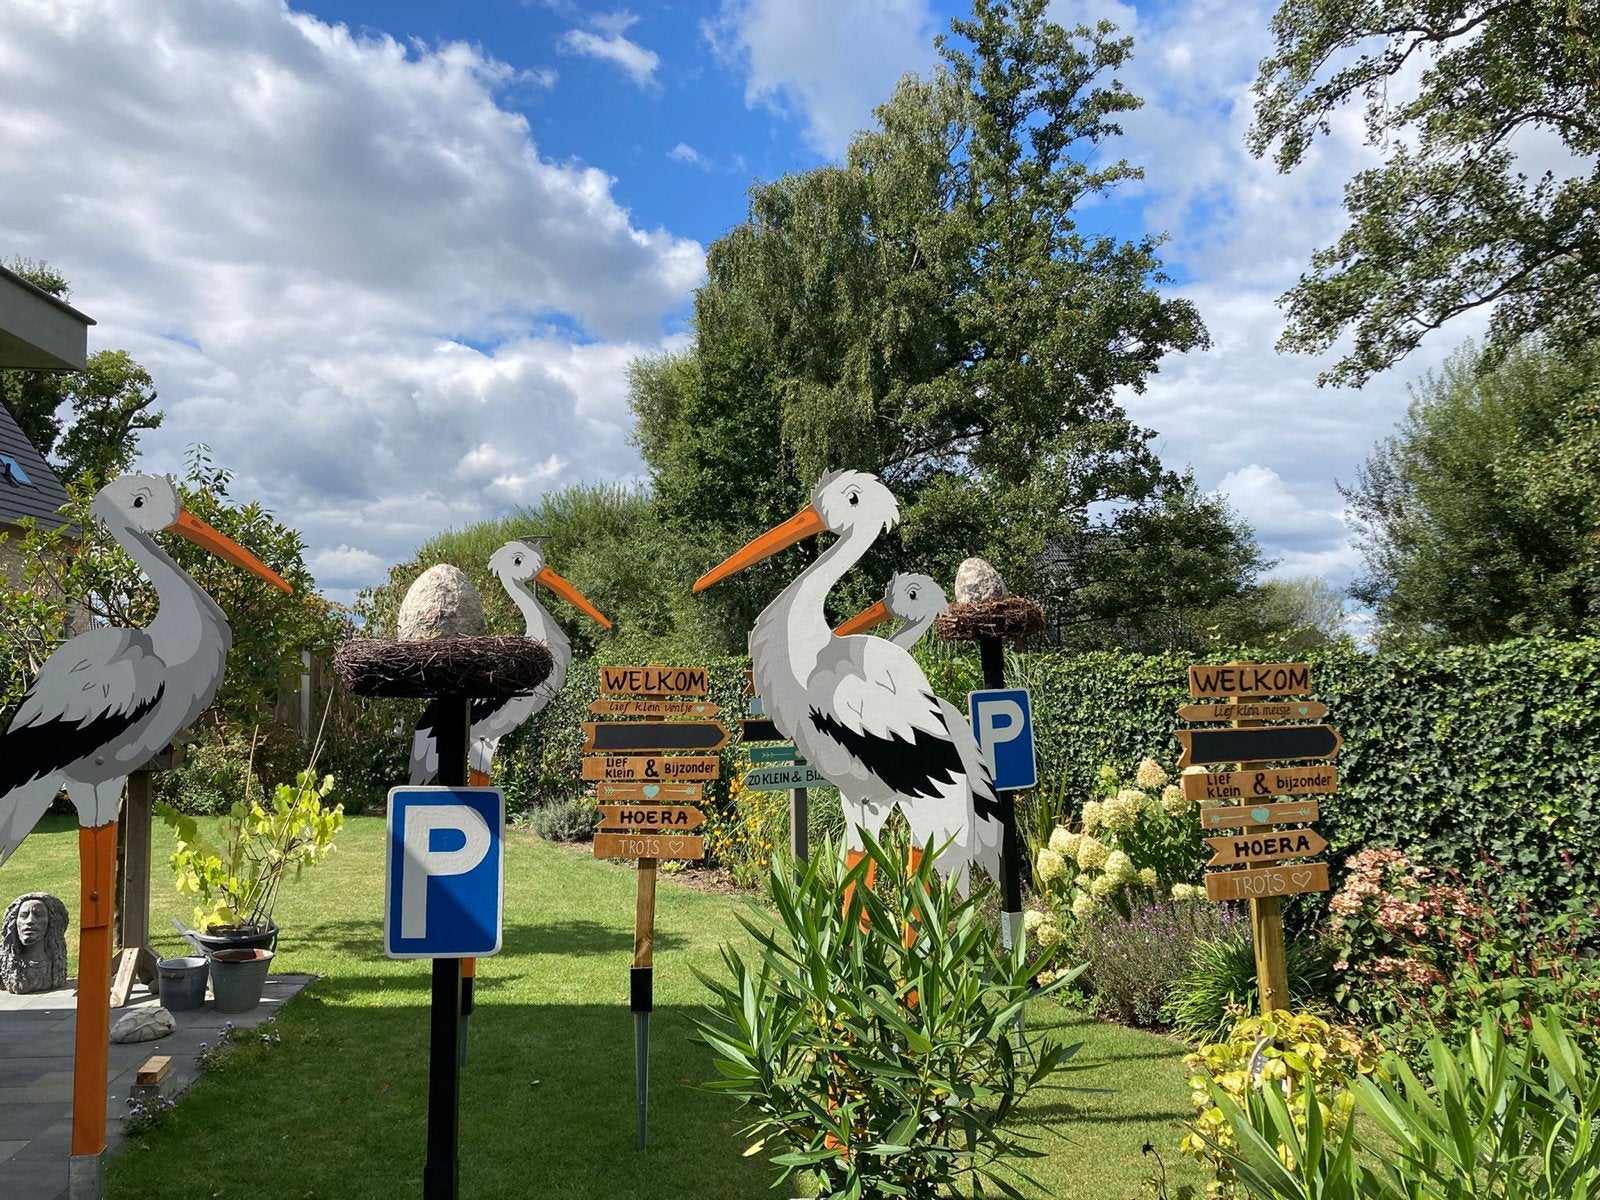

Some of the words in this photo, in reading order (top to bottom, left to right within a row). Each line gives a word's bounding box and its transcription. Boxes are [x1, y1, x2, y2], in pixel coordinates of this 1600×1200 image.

[604, 670, 706, 692] WELKOM
[1193, 668, 1308, 693] WELKOM
[664, 702, 692, 715] ventje
[1262, 704, 1291, 718] meisje
[978, 700, 1025, 781] P
[644, 759, 659, 778] &
[664, 761, 715, 777] Bijzonder
[748, 775, 761, 786] ZO
[762, 772, 790, 785] KLEIN
[791, 771, 802, 782] &
[1253, 772, 1272, 795] &
[1276, 773, 1332, 791] bijzonder
[620, 810, 688, 825] HOERA
[1234, 835, 1311, 858] HOERA
[401, 805, 491, 939] P
